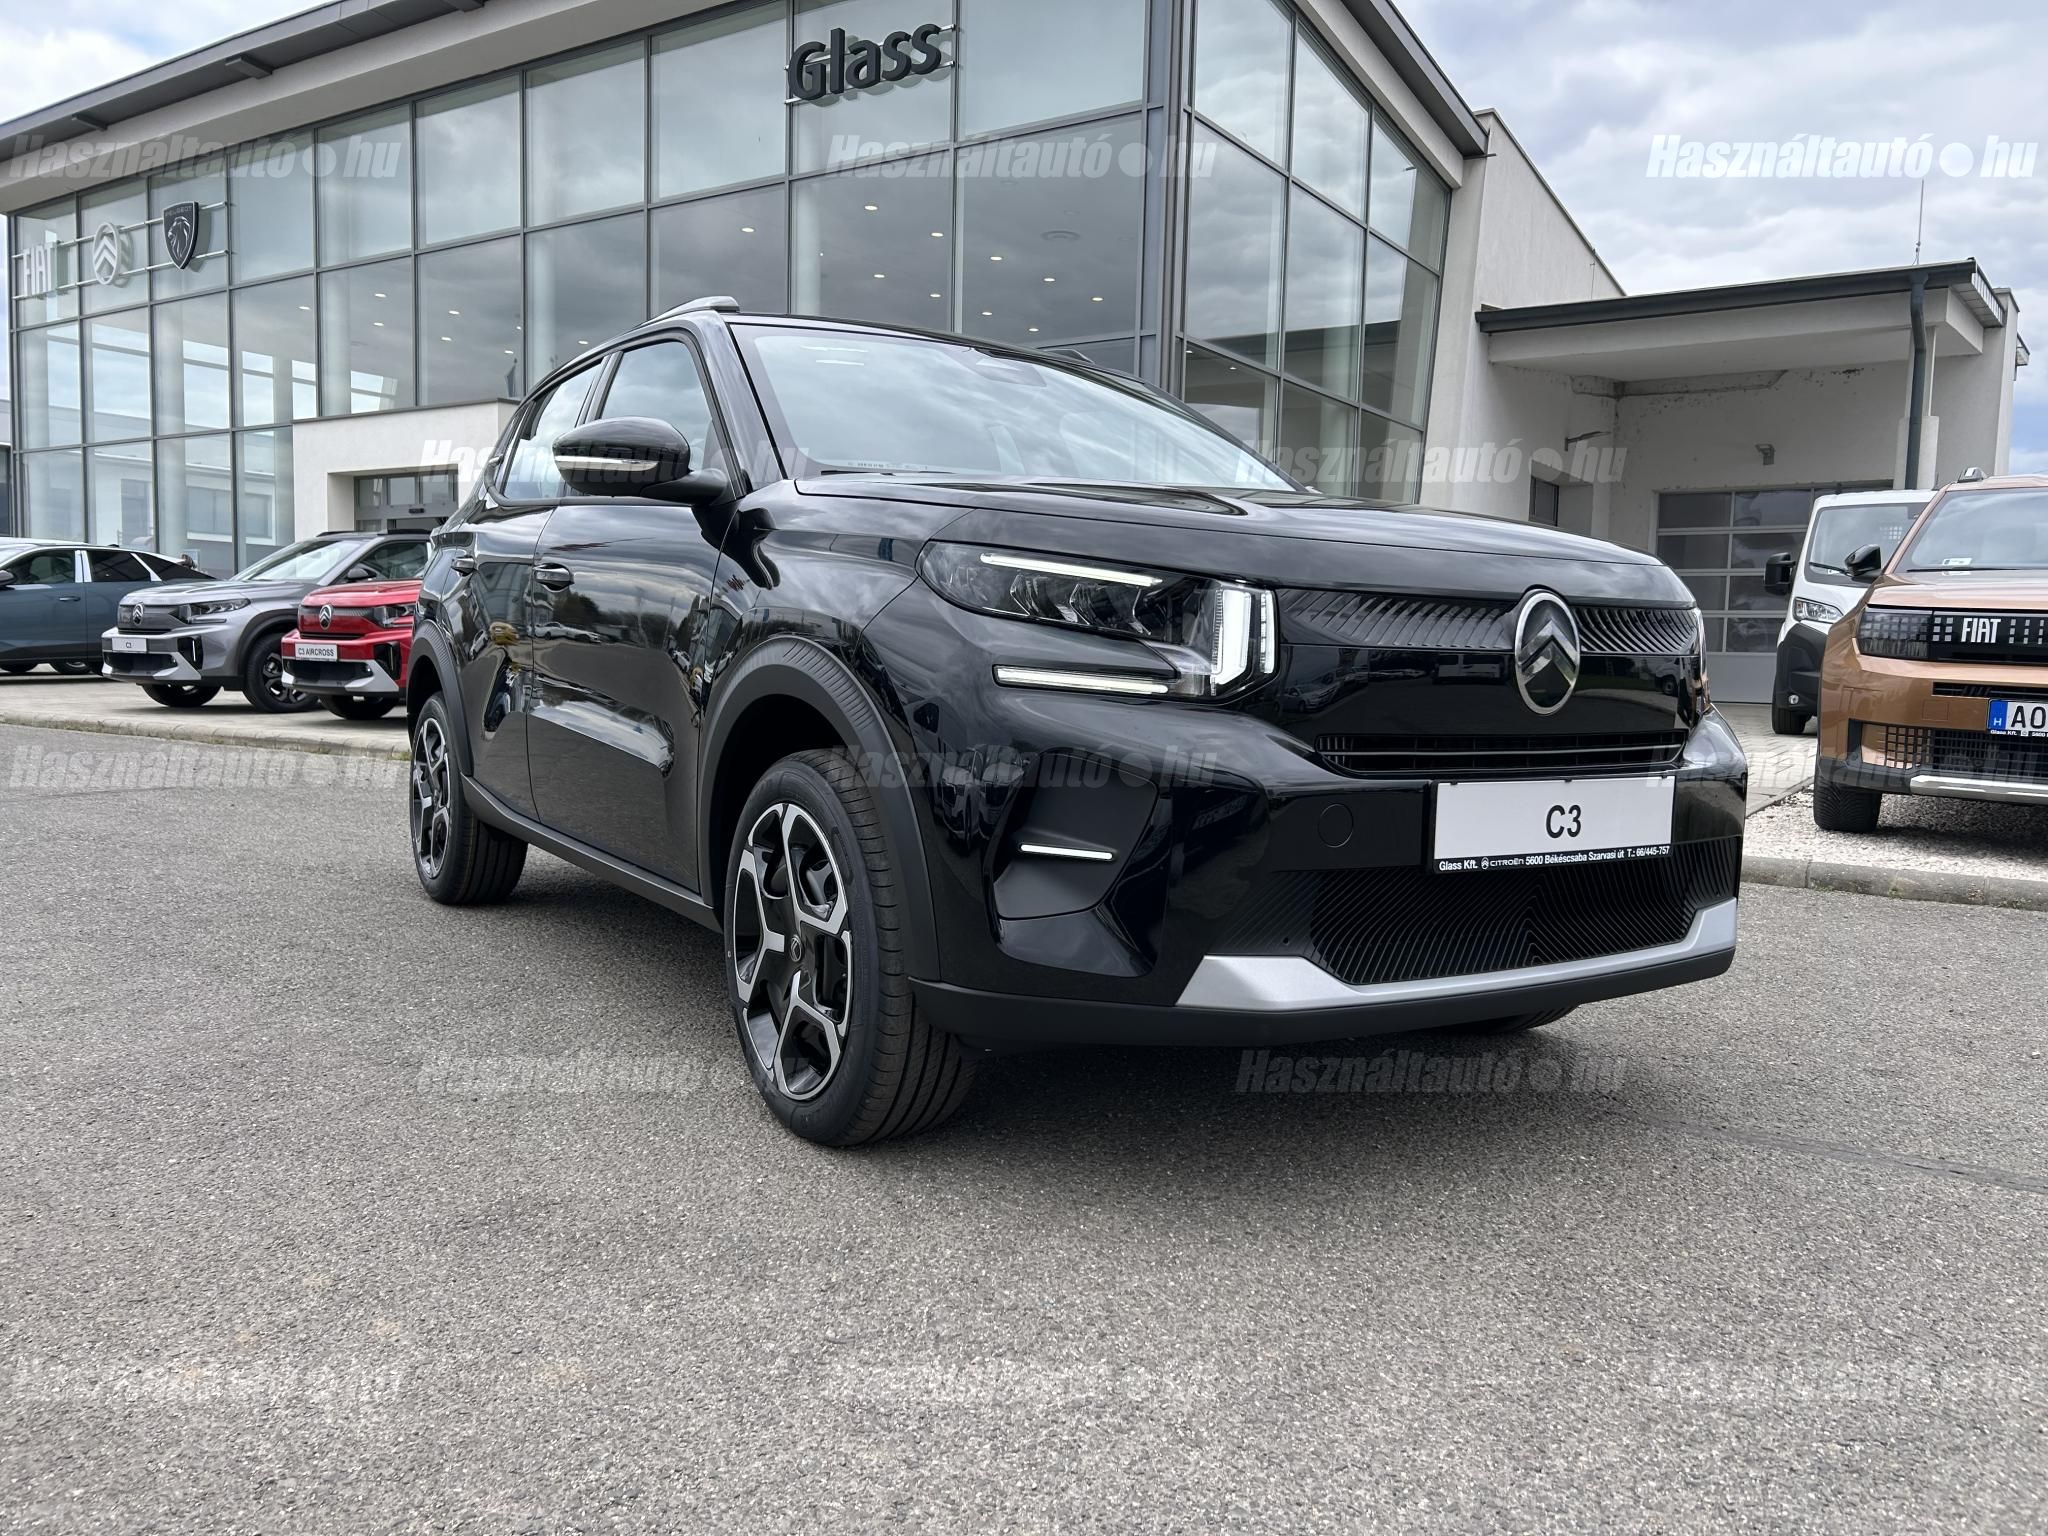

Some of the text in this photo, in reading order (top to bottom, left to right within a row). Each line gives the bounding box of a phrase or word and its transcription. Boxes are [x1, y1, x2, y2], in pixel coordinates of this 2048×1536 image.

[788, 23, 941, 101] Glass
[22, 242, 57, 297] FIAT
[1961, 617, 2001, 643] FIAT
[306, 648, 334, 657] AIRCROSS
[1993, 717, 2002, 726] H
[1546, 804, 1582, 839] C3
[1439, 860, 1462, 871] Glass
[1463, 859, 1478, 870] Kft.
[1525, 856, 1543, 866] 5600
[1544, 853, 1587, 865] Békéscsaba
[1588, 849, 1616, 861] Szarvasi
[1617, 848, 1624, 859] út
